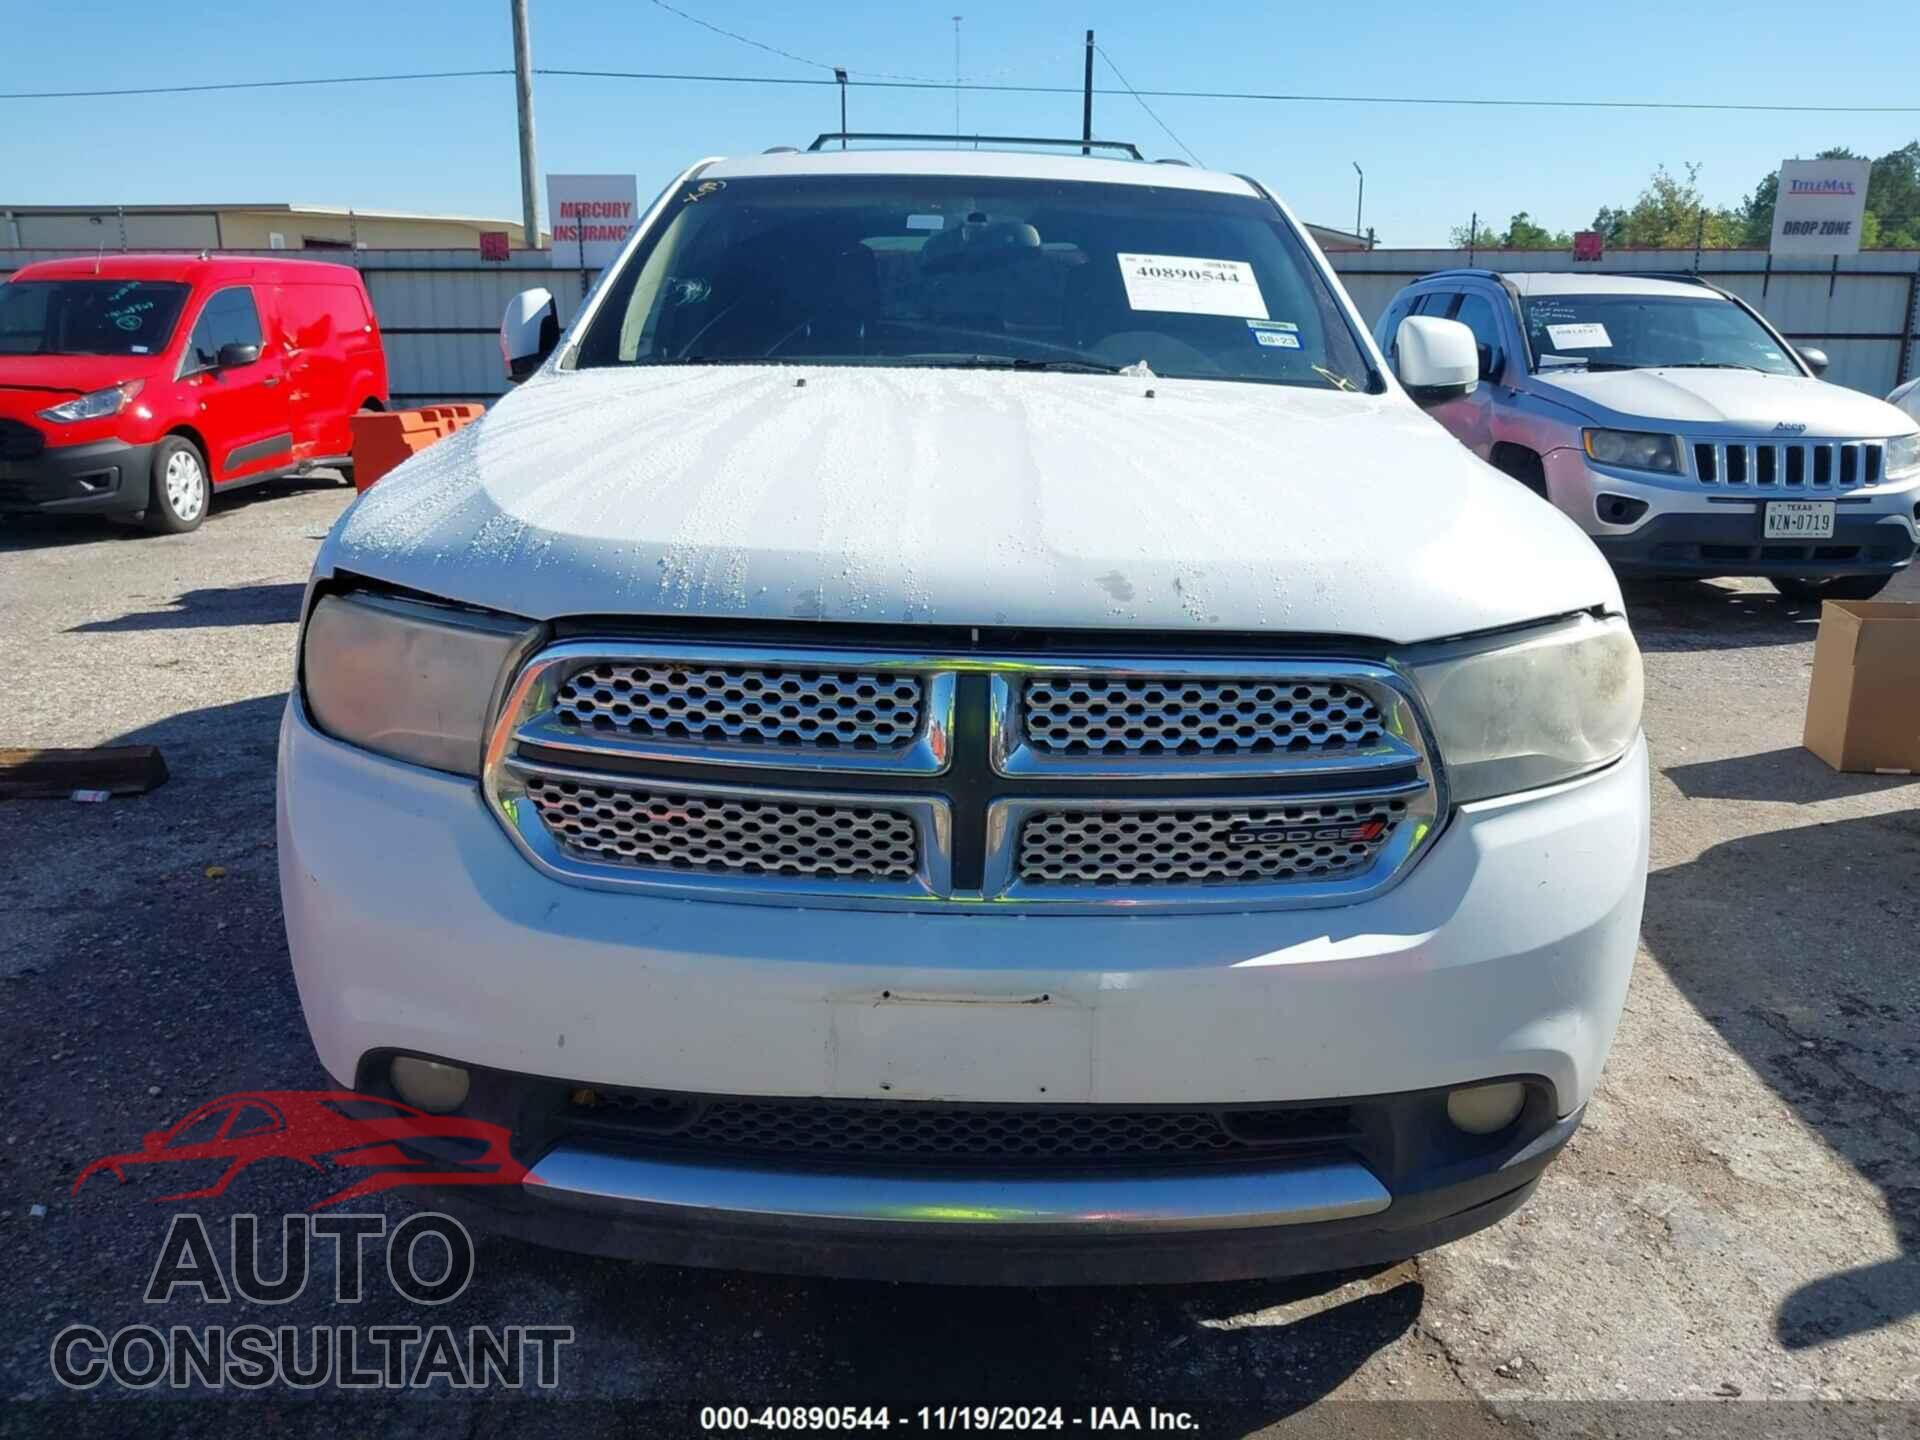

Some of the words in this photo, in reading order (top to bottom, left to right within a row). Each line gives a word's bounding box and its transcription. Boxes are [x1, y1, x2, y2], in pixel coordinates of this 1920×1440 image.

[560, 202, 632, 218] MERCURY
[1782, 221, 1818, 235] DROP
[1819, 221, 1851, 235] ZONE
[1136, 266, 1240, 283] 40890544
[1230, 828, 1367, 843] DODGE
